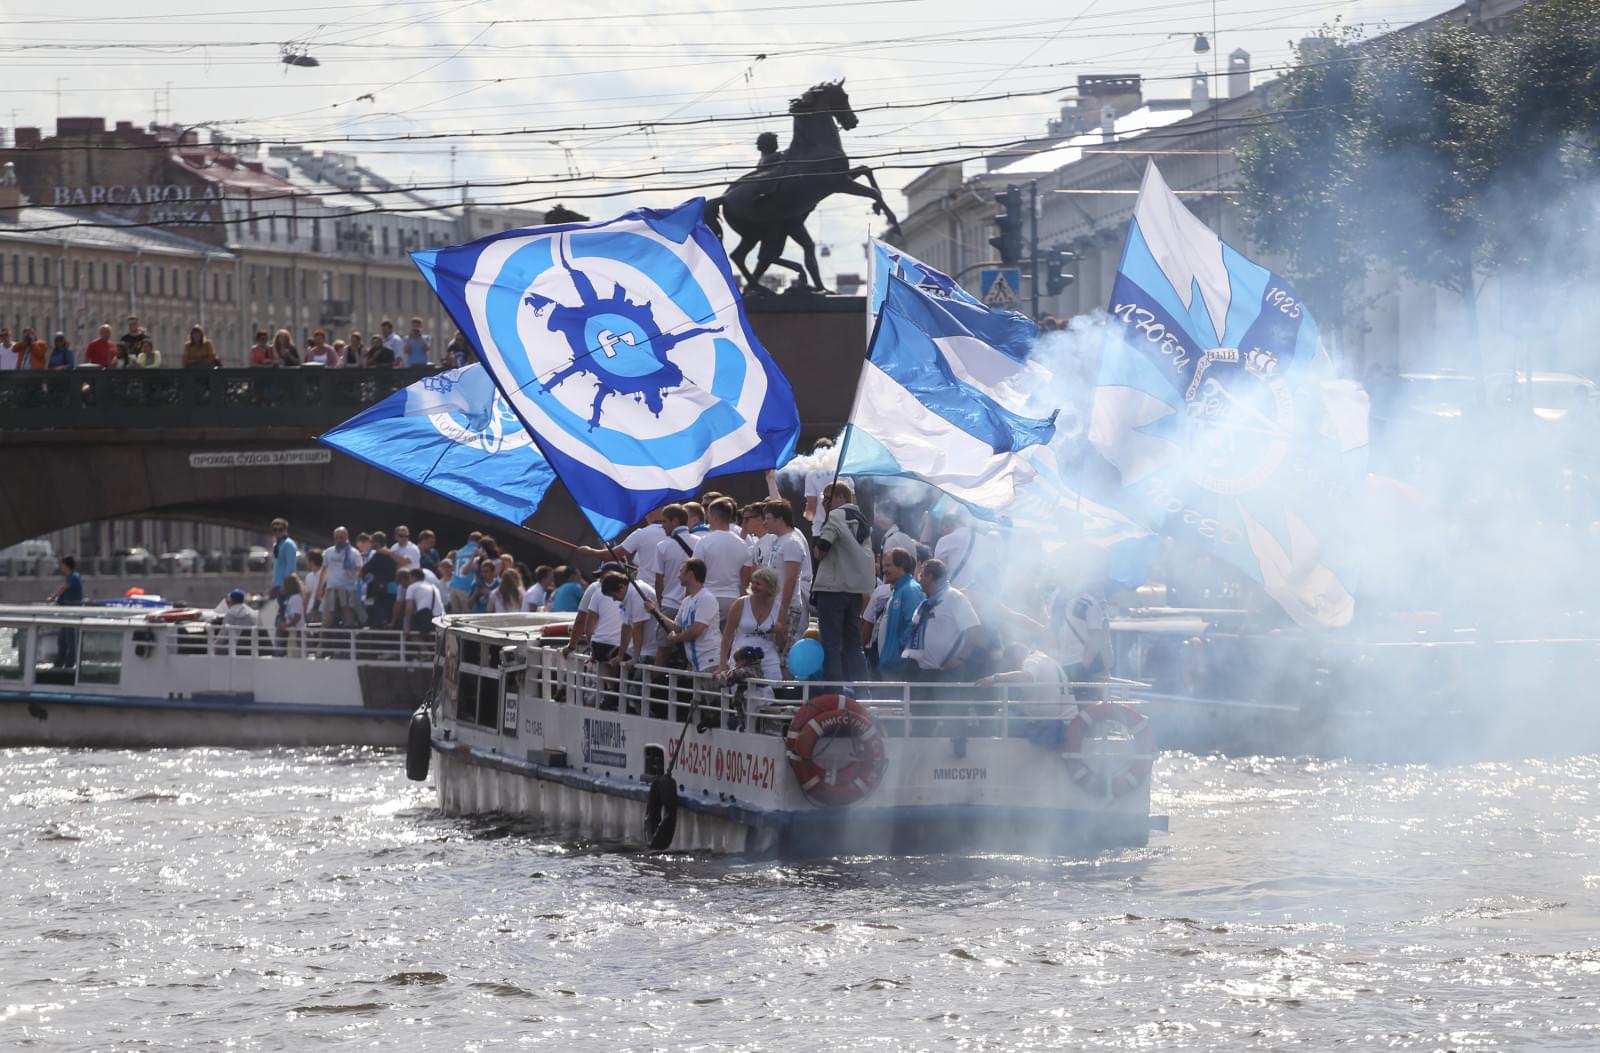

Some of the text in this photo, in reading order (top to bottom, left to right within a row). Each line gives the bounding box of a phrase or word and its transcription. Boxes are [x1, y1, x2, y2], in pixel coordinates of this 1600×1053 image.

[53, 185, 219, 206] BARCAROLA
[1265, 287, 1301, 318] 1925
[193, 451, 329, 465] ПРОХОД СУДОВ ЗАПРЕЩЕН
[726, 748, 775, 791] 900-74-21
[934, 767, 987, 780] МИССУРИ
